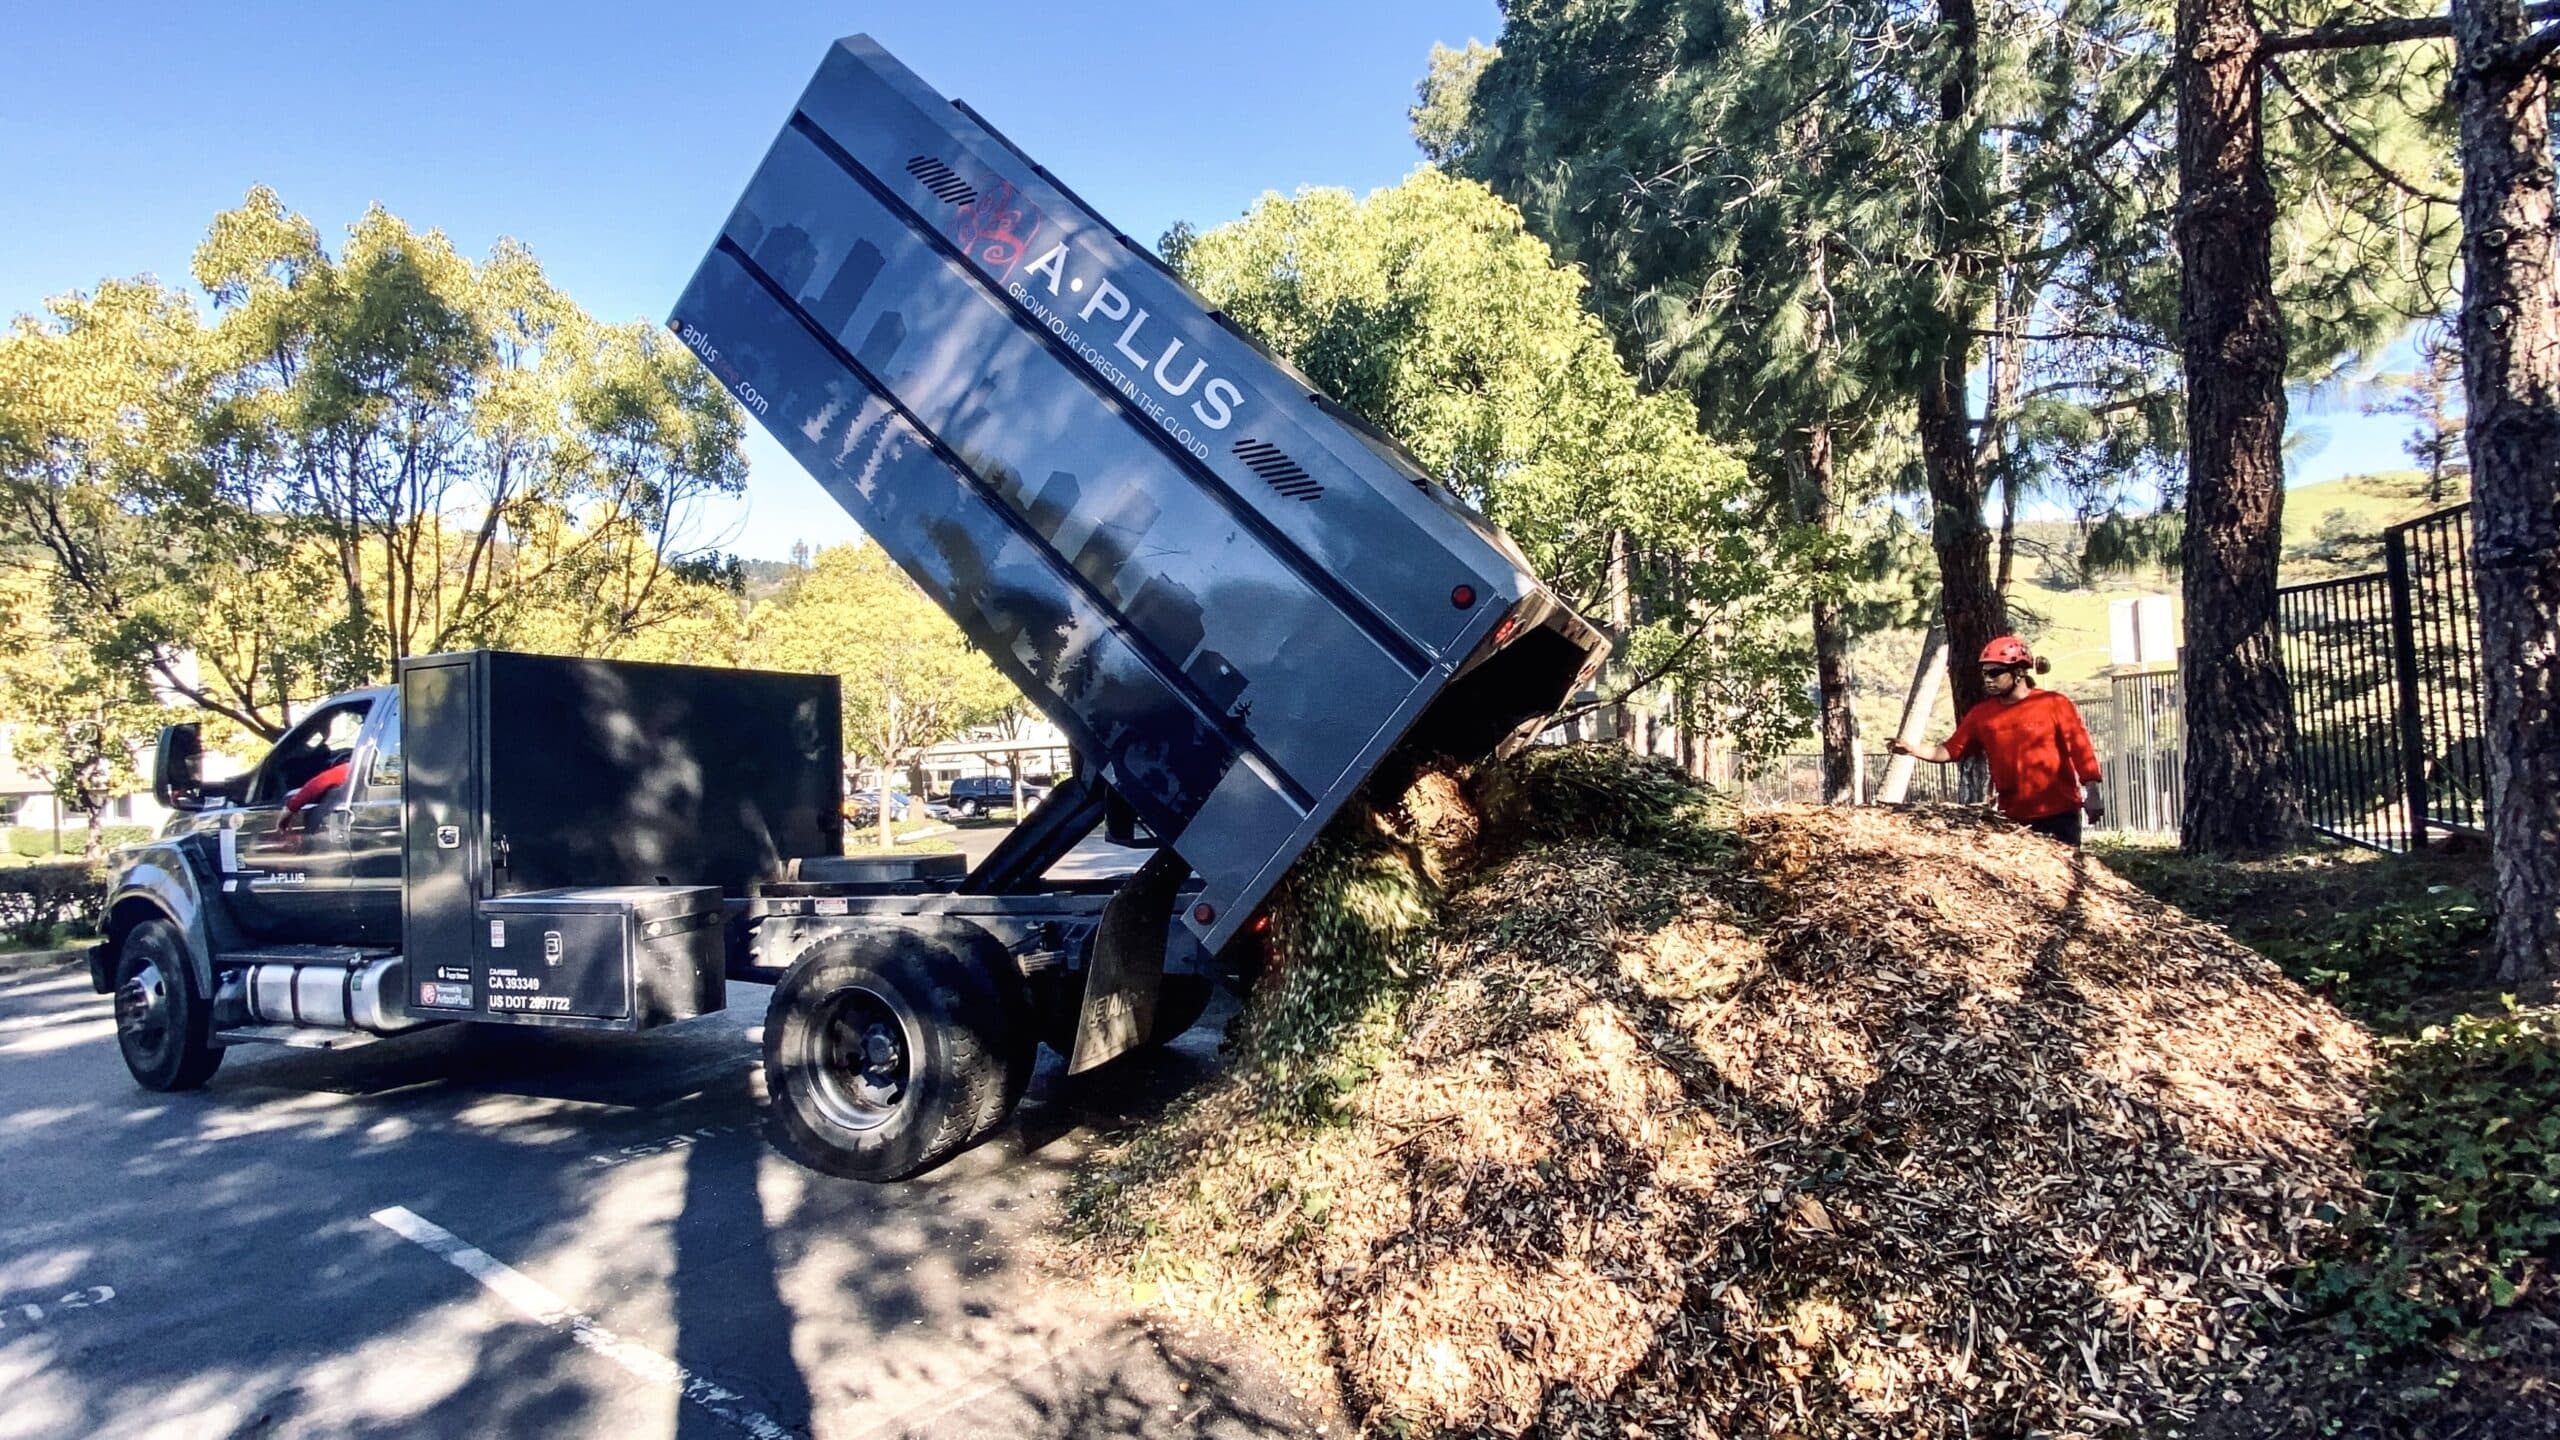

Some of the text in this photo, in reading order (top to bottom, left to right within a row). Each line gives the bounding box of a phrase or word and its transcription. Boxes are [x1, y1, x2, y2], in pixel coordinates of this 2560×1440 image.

[1009, 282, 1209, 460] GROW YOUR FOREST IN THE CLOUD
[489, 976, 540, 990] CA 393349
[489, 995, 504, 1008] US
[505, 995, 528, 1009] DOT
